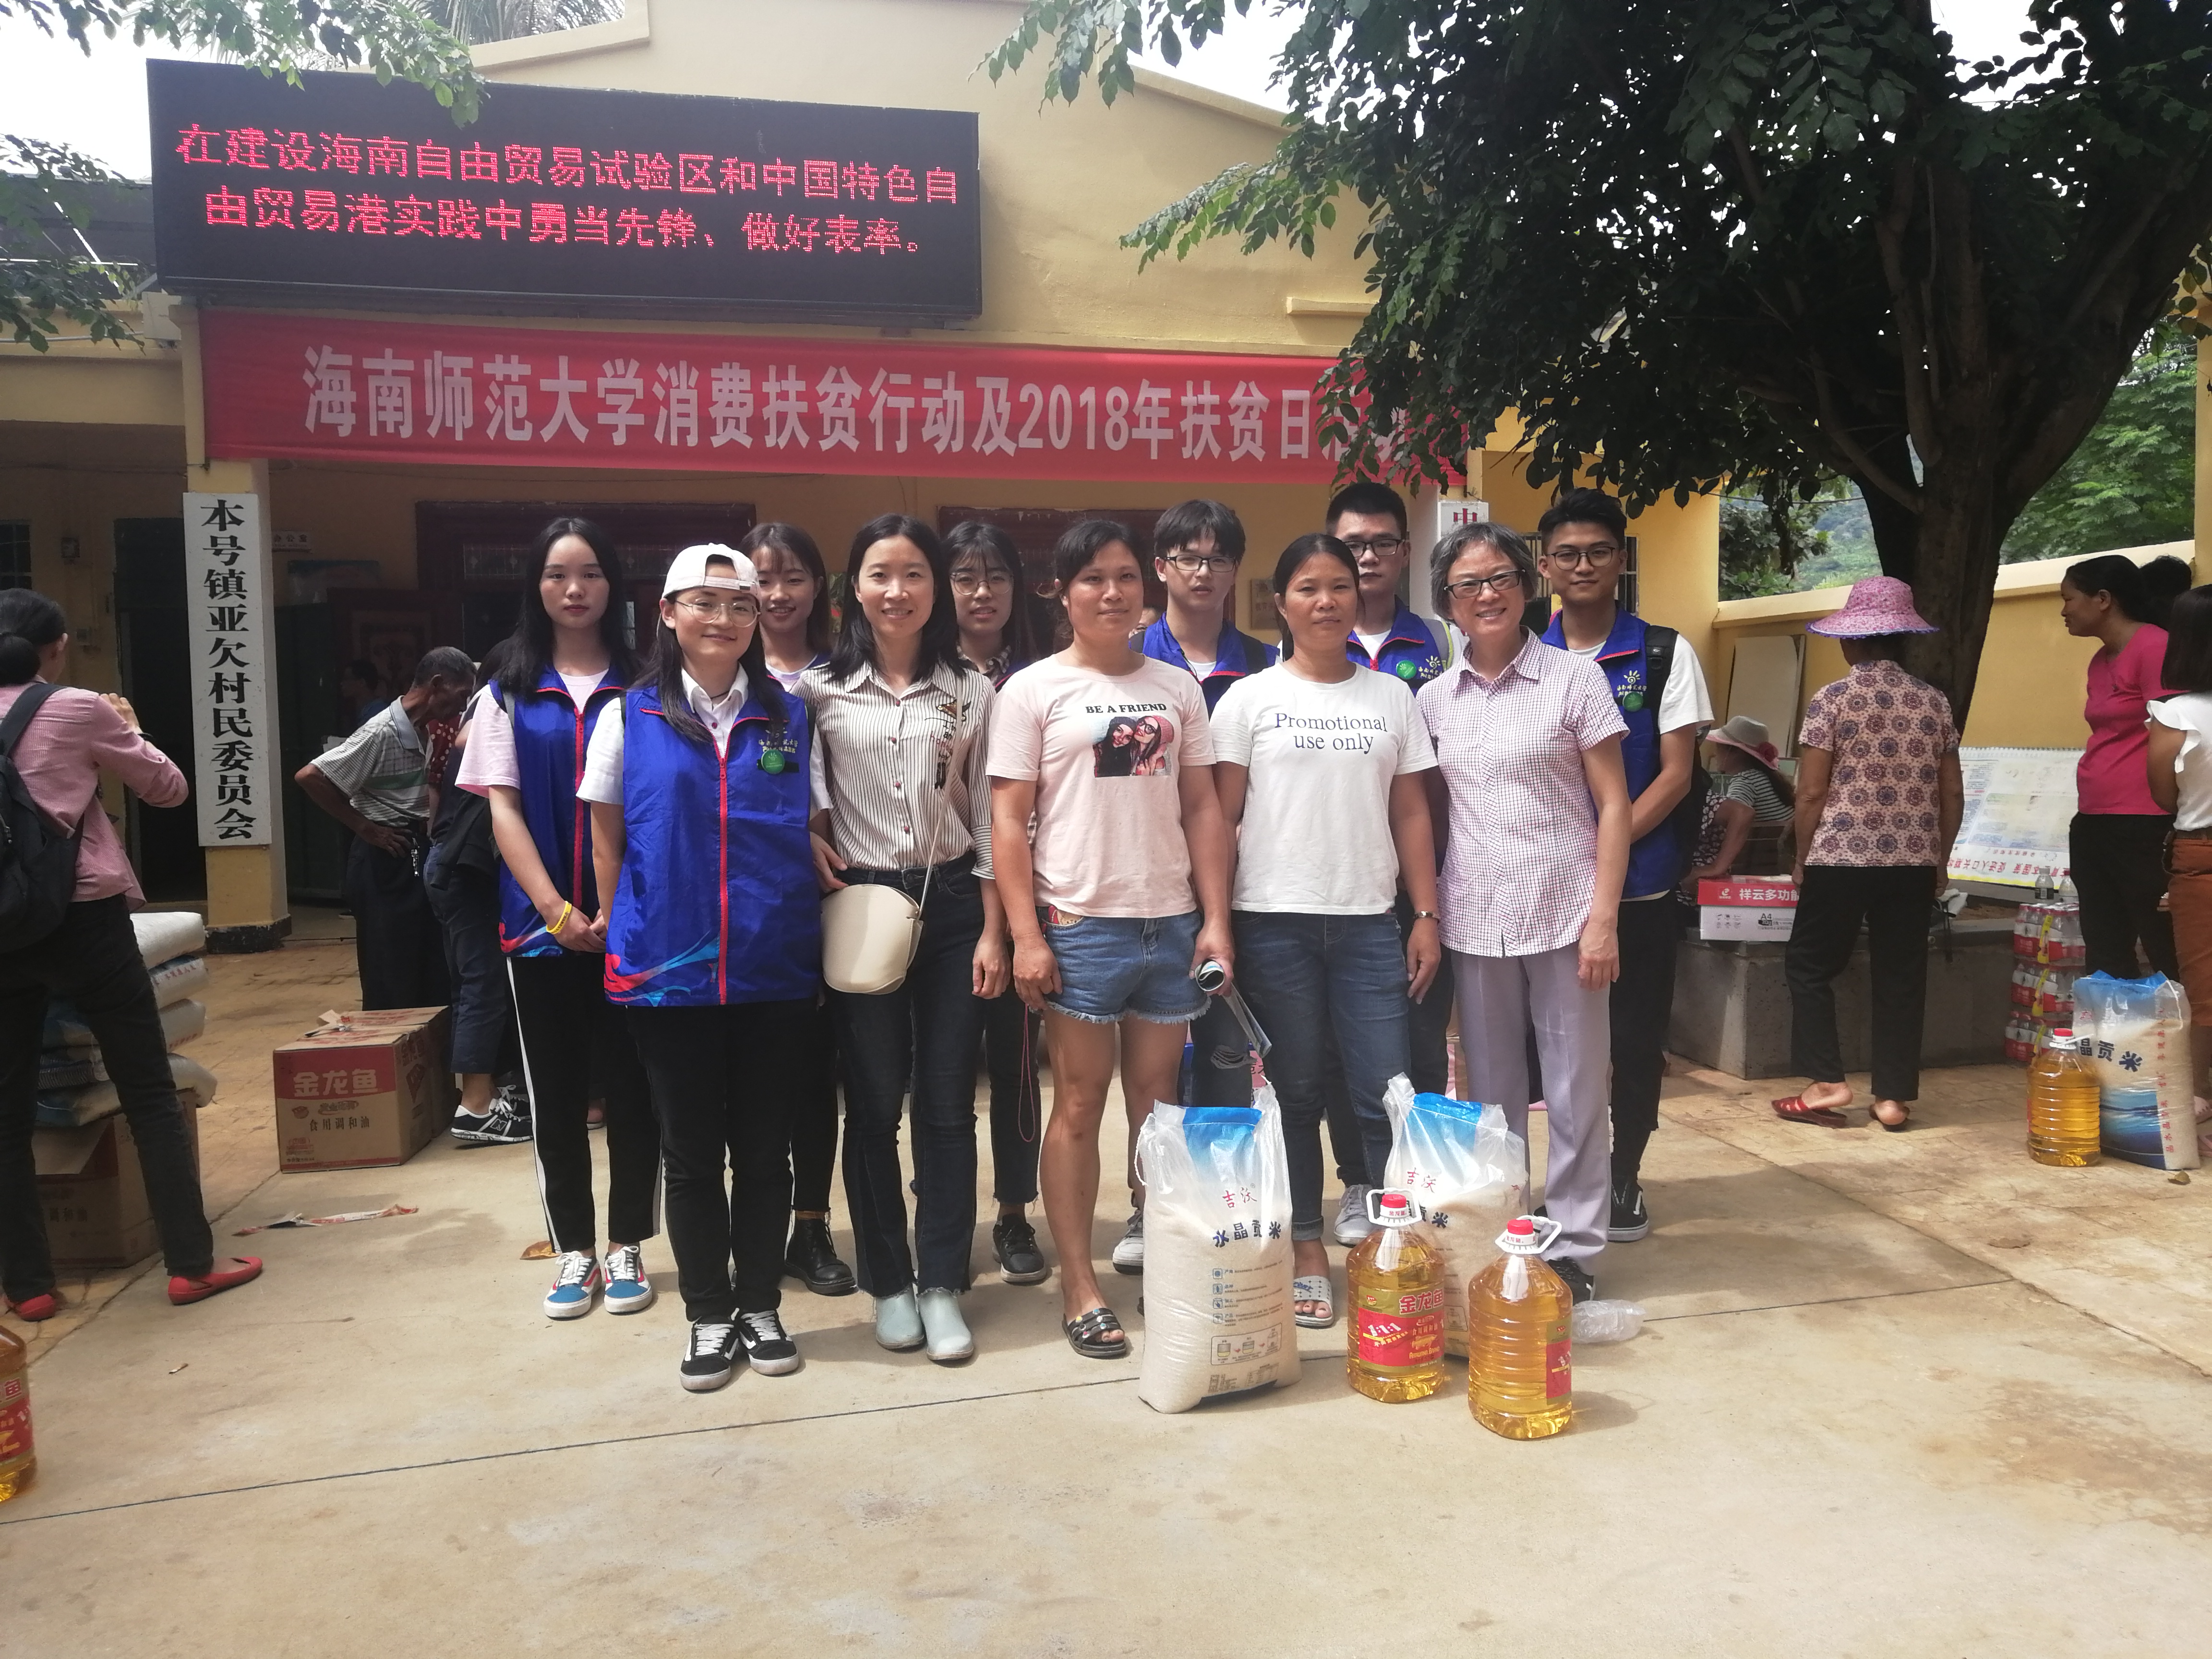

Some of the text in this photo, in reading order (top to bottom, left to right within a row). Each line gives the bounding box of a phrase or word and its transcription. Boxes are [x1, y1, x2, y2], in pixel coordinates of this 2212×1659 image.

[176, 123, 957, 204] 在建设海南自由贸易试验区和中国特色自
[201, 499, 256, 840] 本号镇亚欠村民委员会
[1085, 703, 1167, 713] BE A FRIEND
[1274, 713, 1388, 733] Promotional
[1294, 733, 1374, 754] use only
[293, 1068, 378, 1097] 金龙鱼
[310, 1116, 370, 1131] 食用调和油
[1213, 1220, 1282, 1248] 水晶贡米
[1399, 1288, 1444, 1315] 金龙鱼
